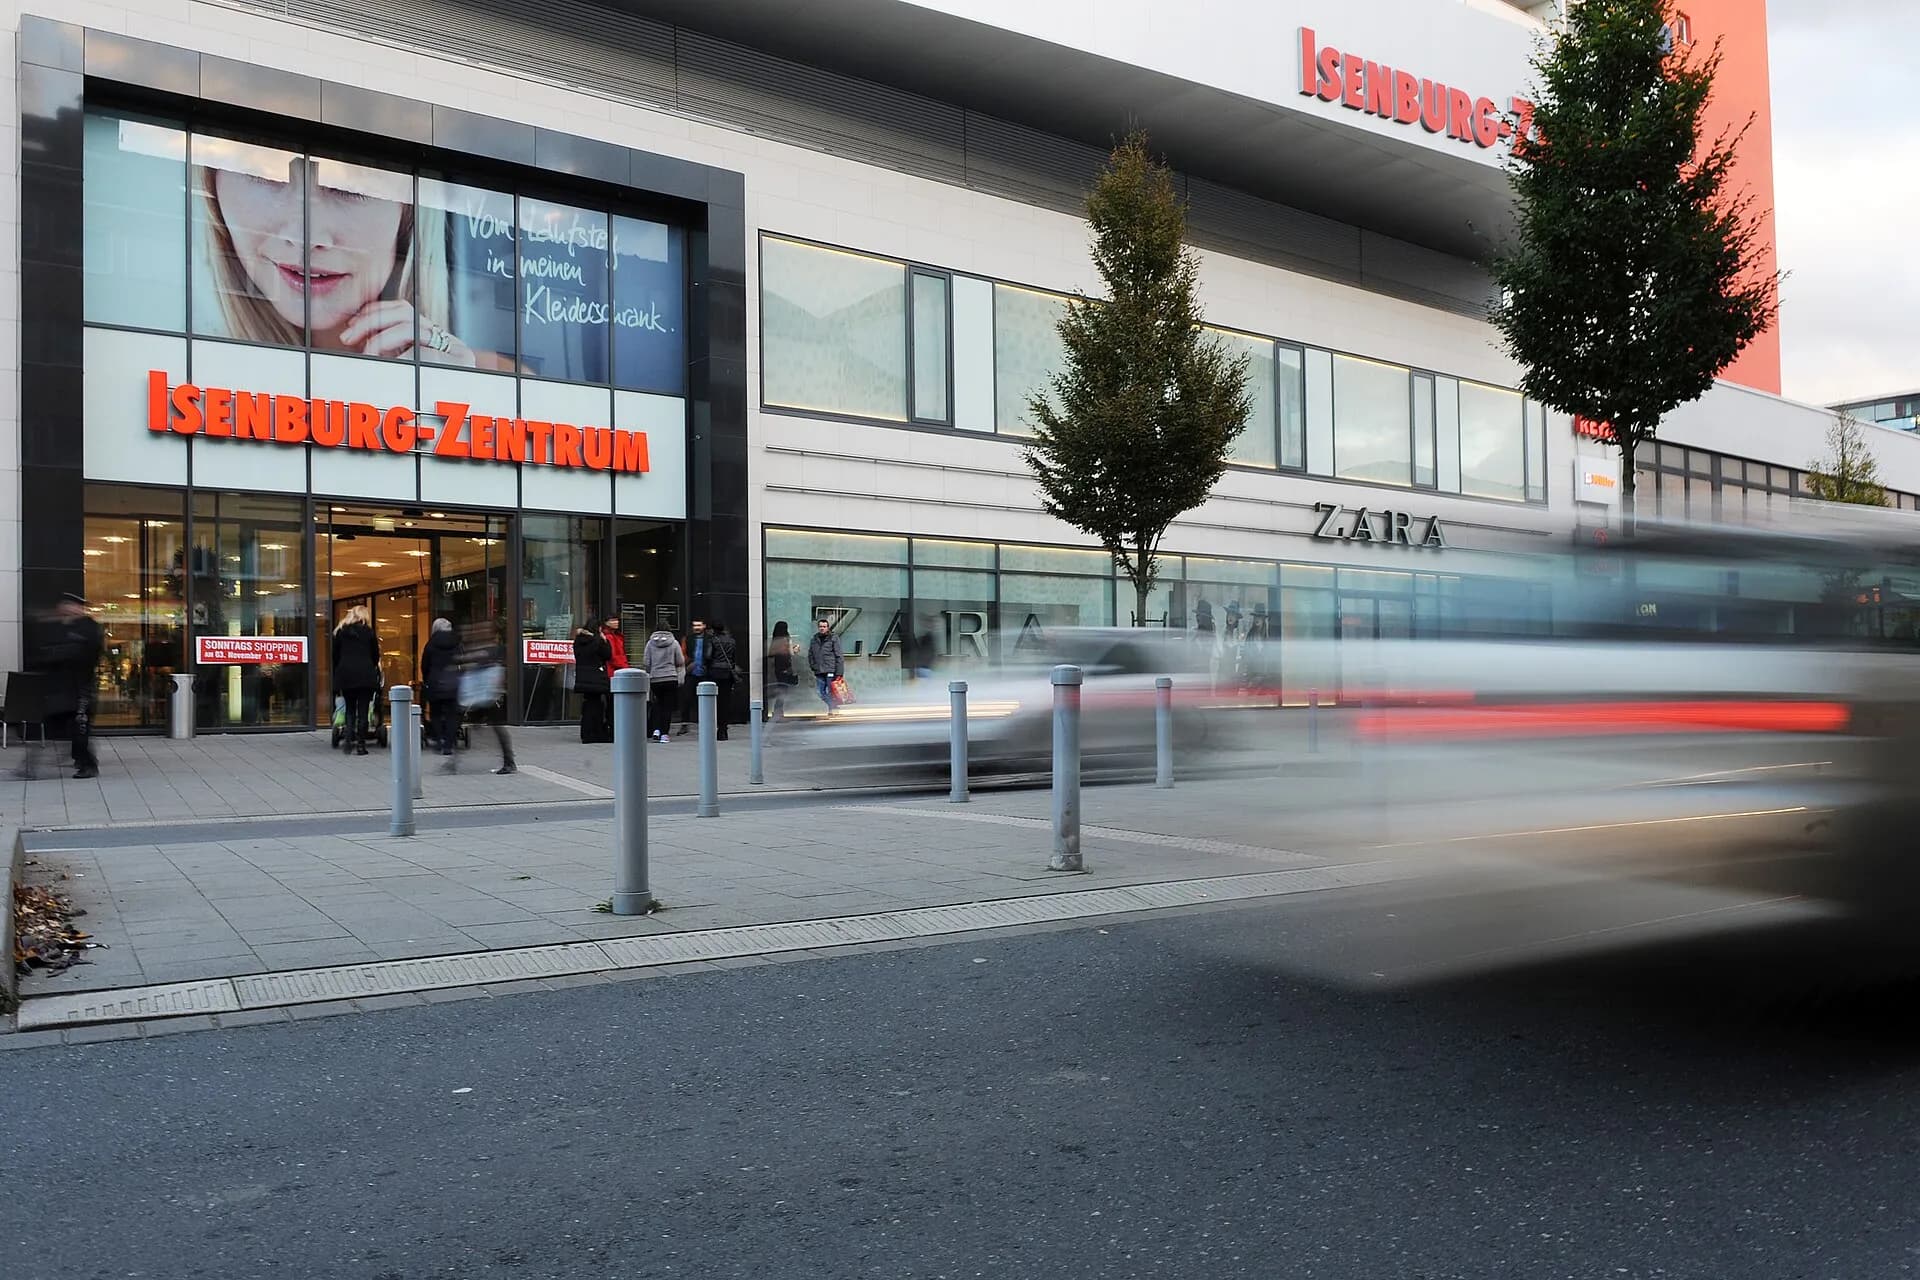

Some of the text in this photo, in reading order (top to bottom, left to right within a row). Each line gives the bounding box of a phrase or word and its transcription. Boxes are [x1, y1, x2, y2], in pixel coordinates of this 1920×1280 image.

[1297, 26, 1552, 158] ISENBURG-Z
[467, 200, 521, 241] Vom
[486, 249, 587, 287] in meinen
[1314, 500, 1448, 549] ZARA
[445, 578, 470, 593] ZARA
[205, 640, 298, 653] SONNTAGS SHOPPING
[228, 651, 262, 660] November
[530, 642, 568, 652] SONNTAGS
